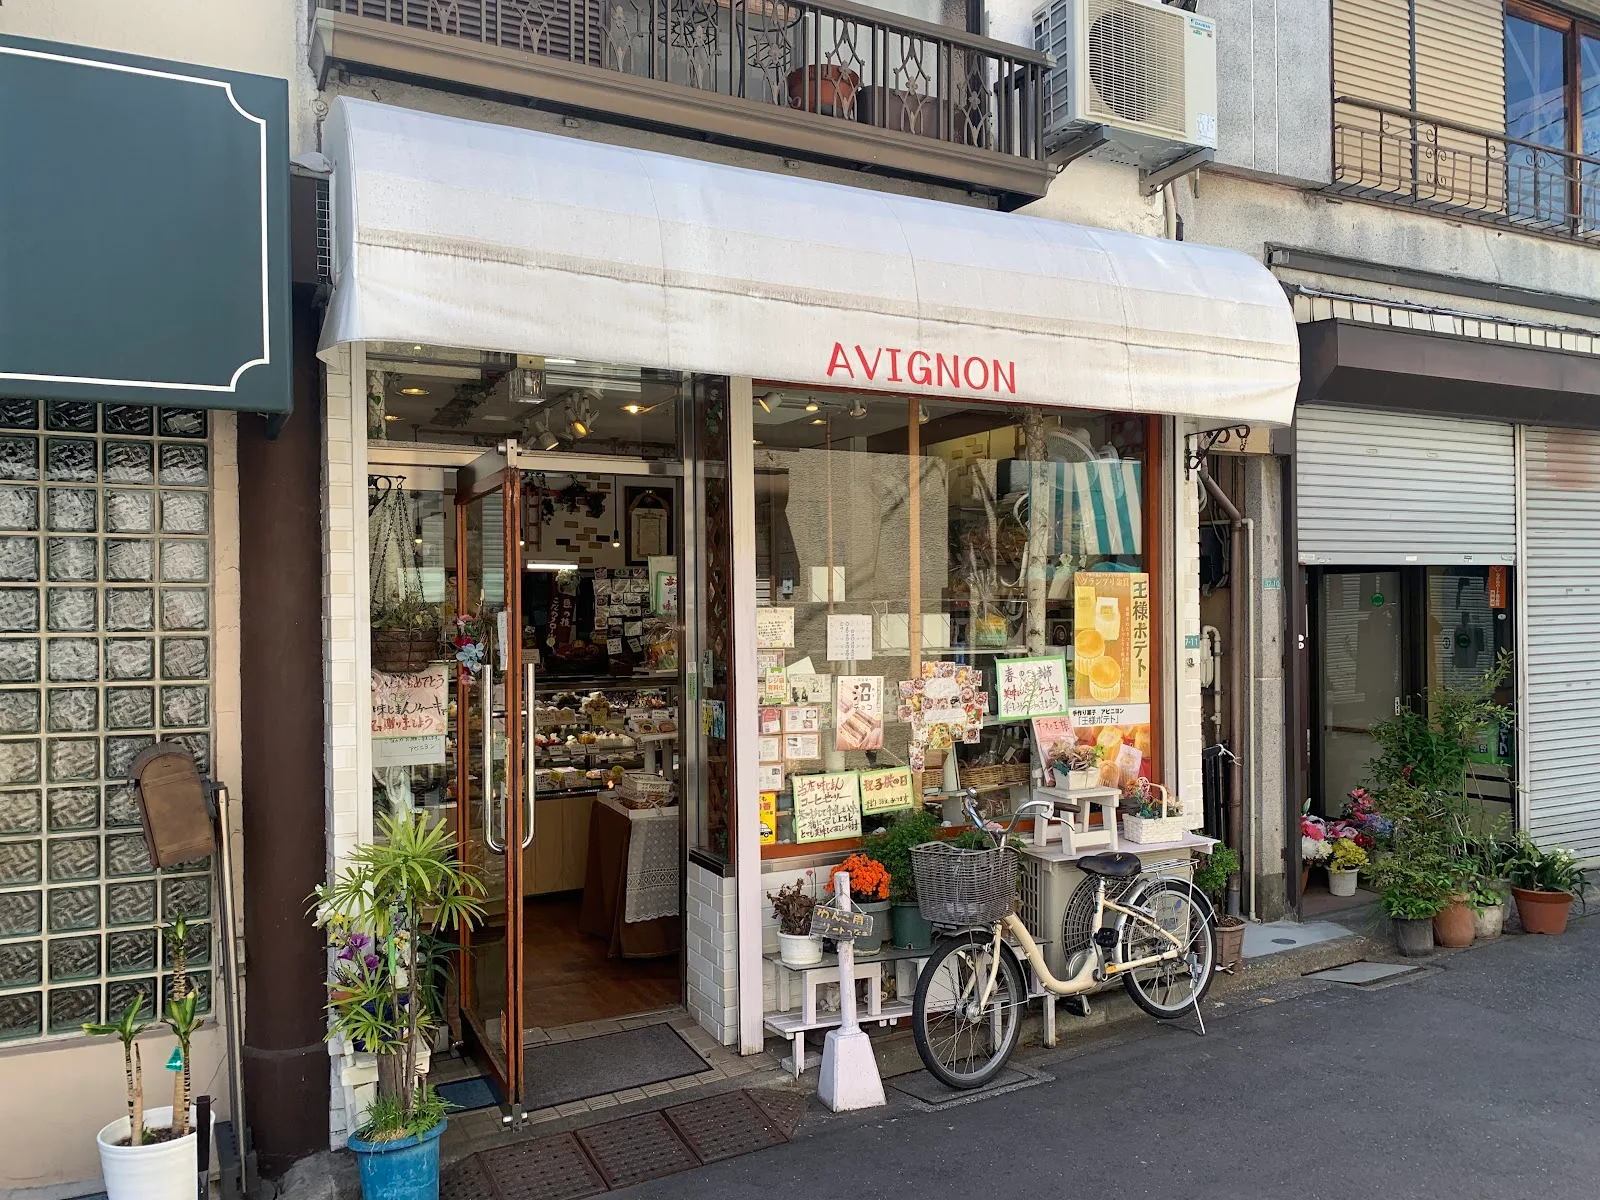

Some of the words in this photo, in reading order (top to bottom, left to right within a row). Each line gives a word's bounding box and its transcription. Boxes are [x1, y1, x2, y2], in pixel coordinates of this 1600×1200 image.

[826, 342, 1016, 393] AVIGNON
[1133, 580, 1149, 677] 王様ポテト
[1072, 709, 1097, 717] 手作り菓子
